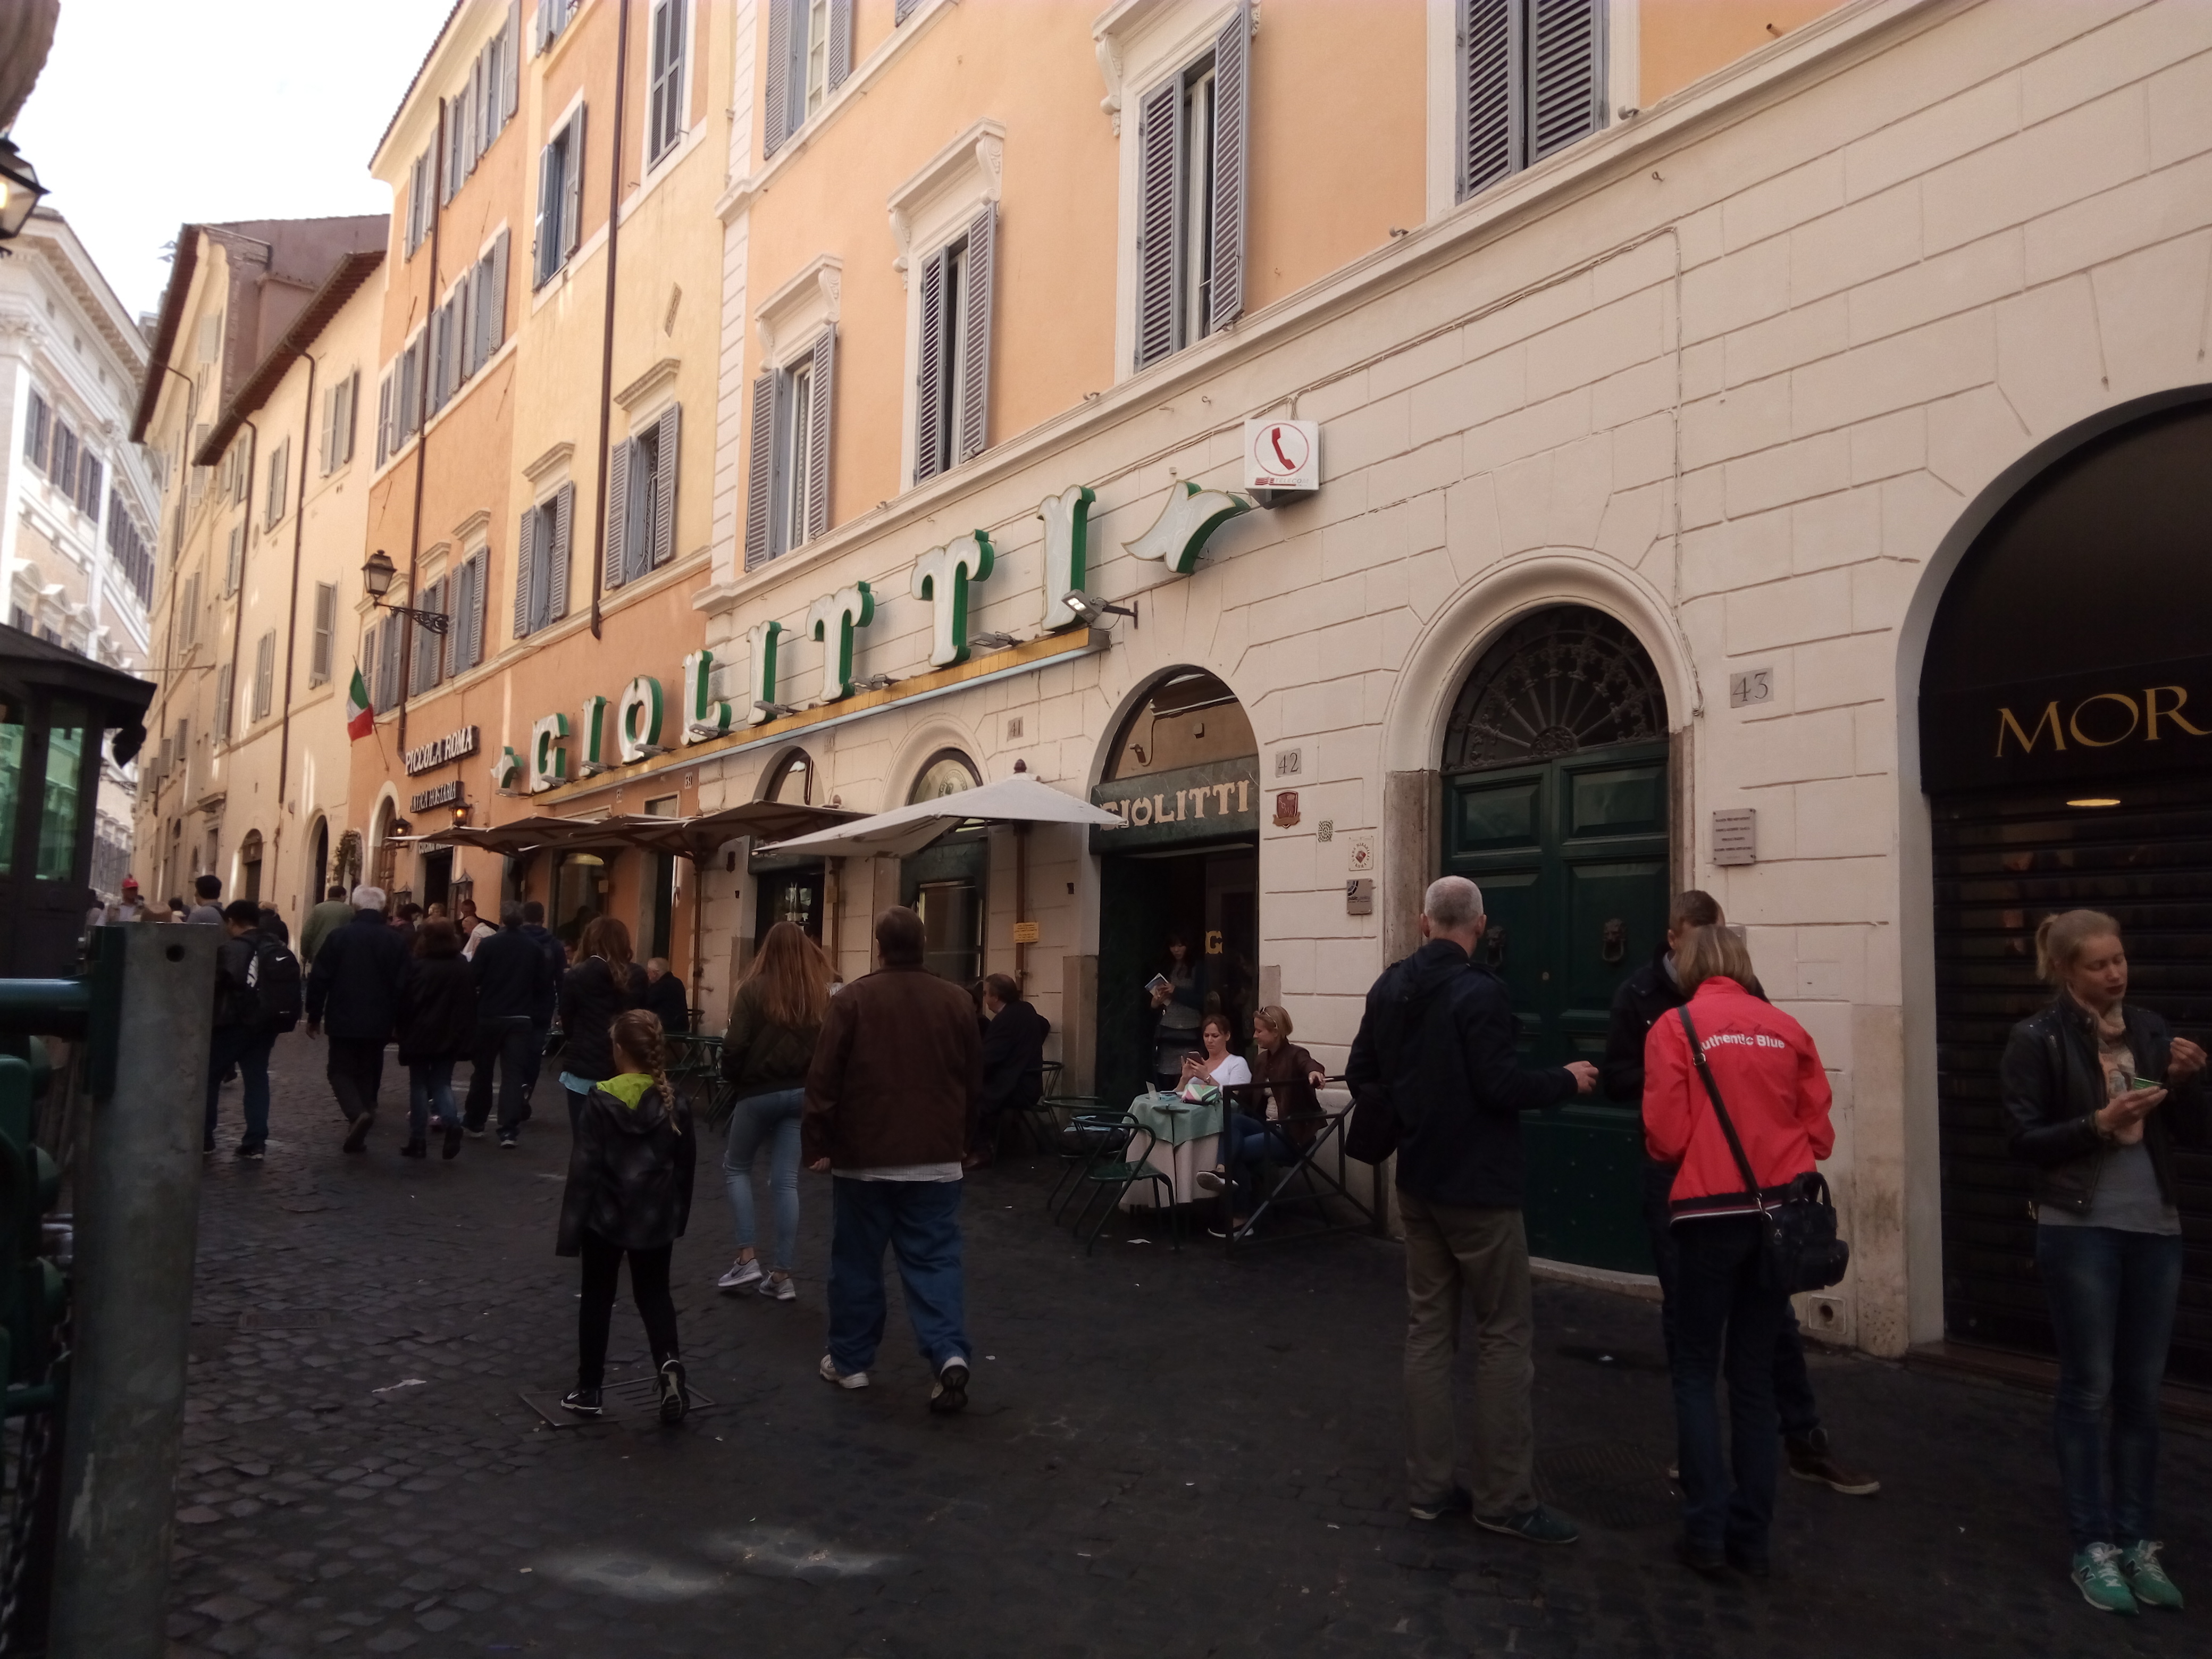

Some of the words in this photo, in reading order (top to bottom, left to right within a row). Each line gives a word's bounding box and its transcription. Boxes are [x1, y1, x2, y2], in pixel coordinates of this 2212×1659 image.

[529, 484, 1096, 795] GIOLITTI
[1732, 672, 1768, 702] 43
[1010, 719, 1021, 737] 41
[1994, 686, 2212, 758] MOR
[405, 739, 442, 775] PICCOLA
[443, 725, 473, 761] ROMA
[1278, 752, 1298, 774] 42
[410, 790, 428, 812] ANTICA
[429, 781, 456, 807] HOSTARIA
[1701, 1034, 1754, 1051] uthentic
[1756, 1035, 1785, 1049] Blue
